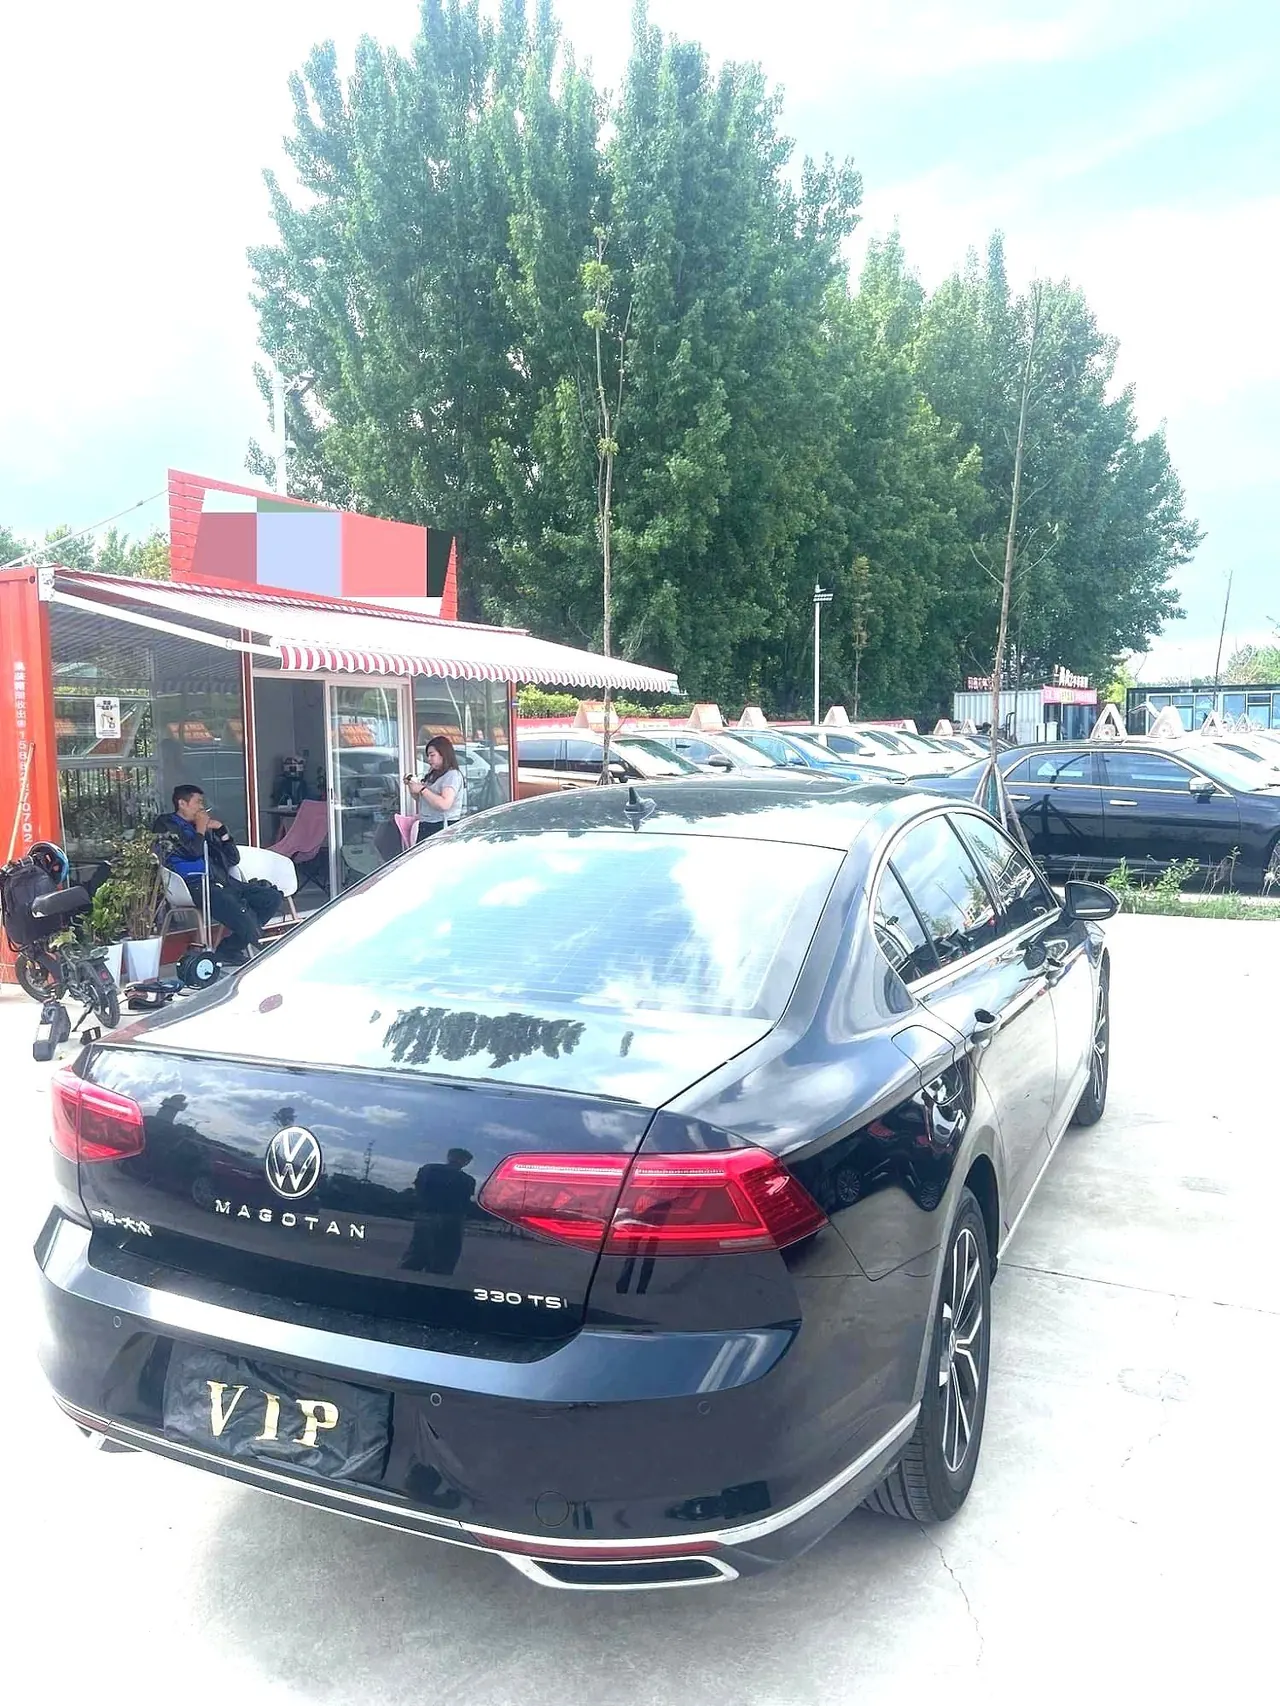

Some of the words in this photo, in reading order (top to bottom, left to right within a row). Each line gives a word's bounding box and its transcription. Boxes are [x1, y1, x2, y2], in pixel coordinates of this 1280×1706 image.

[214, 1199, 366, 1239] MAGOTAN
[473, 1287, 522, 1305] 330
[527, 1293, 568, 1309] TSI
[206, 1380, 339, 1448] VIP
